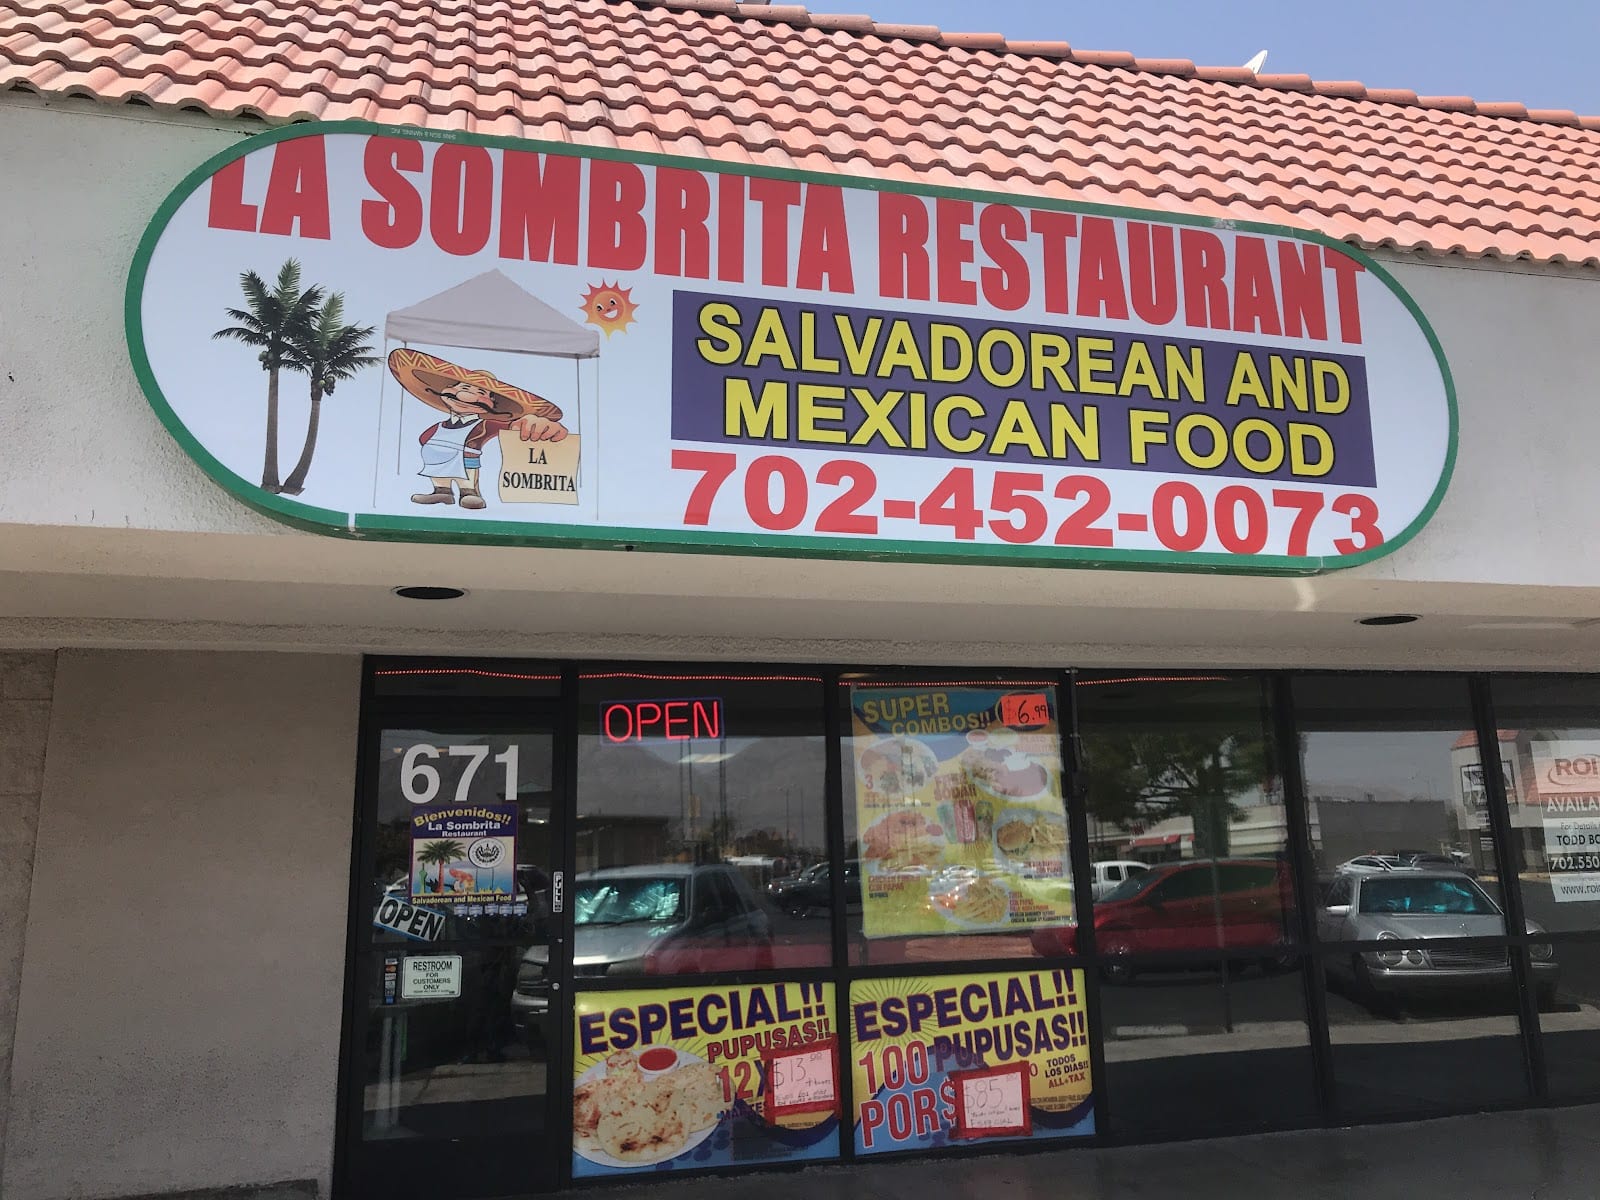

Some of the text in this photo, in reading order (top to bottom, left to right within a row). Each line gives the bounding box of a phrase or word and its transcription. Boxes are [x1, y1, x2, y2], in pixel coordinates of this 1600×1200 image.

[208, 134, 1365, 344] LA SOMBRITA RESTAURANT
[697, 302, 1351, 415] SALVADOREAN AND
[724, 377, 1336, 478] MEXICAN FOOD
[528, 447, 548, 465] LA
[503, 471, 576, 492] SOMBRITA
[671, 450, 1385, 556] 702-452-0073
[604, 701, 720, 742] OPEN
[863, 693, 950, 723] SUPER
[891, 711, 991, 737] COMBOS!!
[400, 744, 519, 803] 671
[413, 807, 512, 827] Bienvenidos!!
[1547, 796, 1600, 812] AVAILA
[428, 821, 501, 831] La Sombrita
[1556, 835, 1586, 845] TODD
[467, 895, 494, 903] Mexican
[496, 894, 512, 902] Food
[380, 899, 443, 940] OPEN
[413, 961, 452, 971] RESTROOM
[579, 983, 826, 1055] ESPECIAL!!
[854, 968, 1078, 1042] ESPECIAL!!
[707, 1018, 831, 1063] PUPUSAS!!
[859, 1011, 1087, 1095] 100 PUPUSAS!!
[1045, 1060, 1089, 1078] LOS DIAS!!
[1046, 1054, 1076, 1067] TODOS
